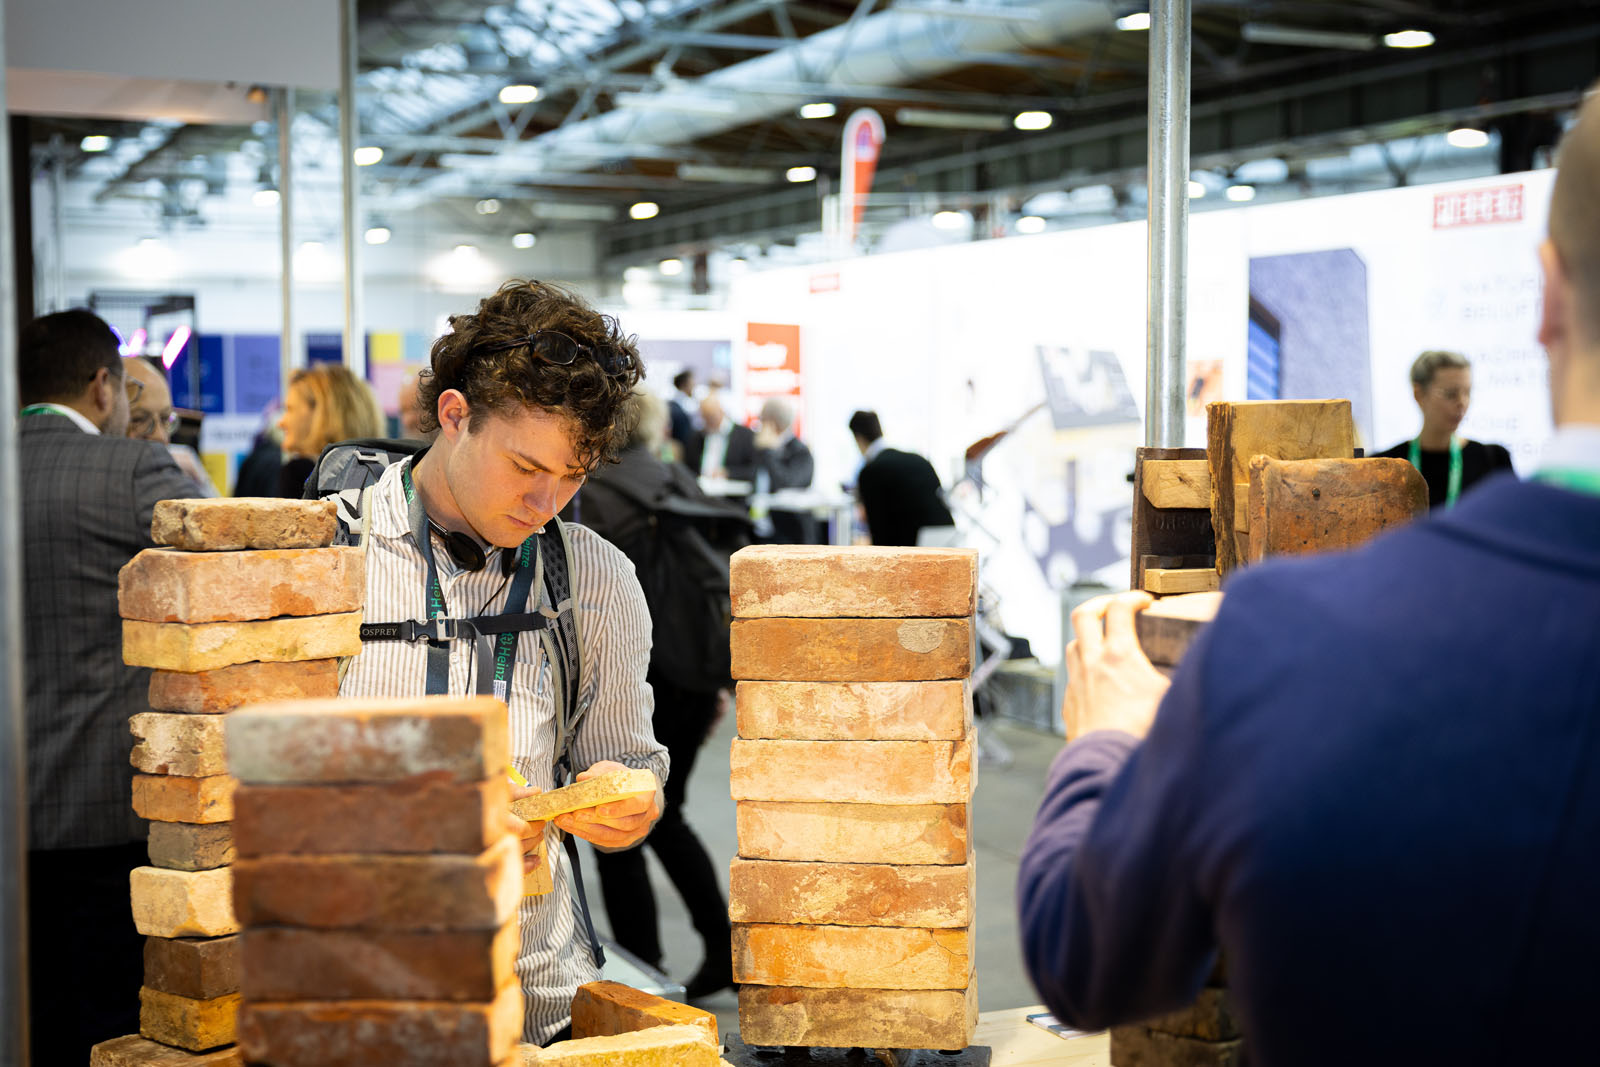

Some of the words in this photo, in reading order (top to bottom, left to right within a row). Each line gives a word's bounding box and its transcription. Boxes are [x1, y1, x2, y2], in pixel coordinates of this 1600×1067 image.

[521, 537, 534, 567] einze
[431, 578, 443, 607] Hein
[362, 628, 397, 636] OSPREY
[494, 646, 511, 681] Heinz
